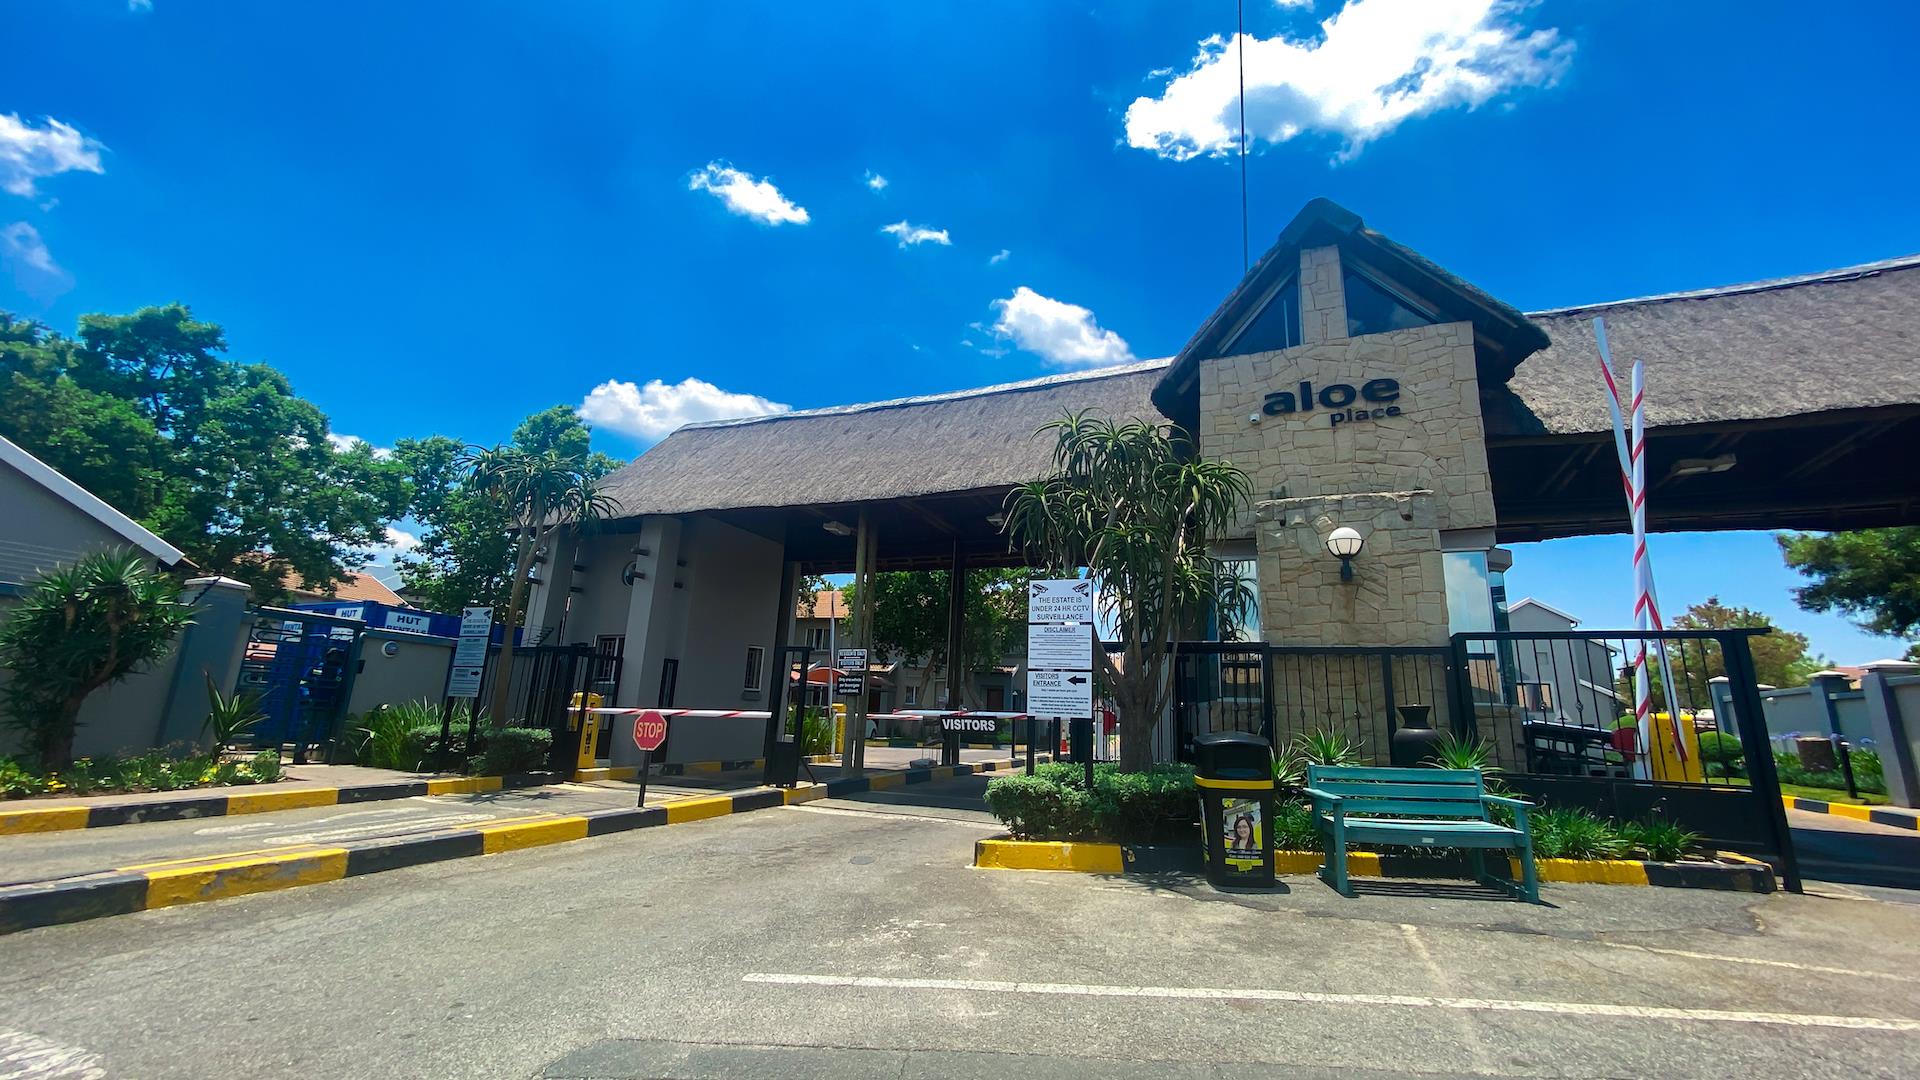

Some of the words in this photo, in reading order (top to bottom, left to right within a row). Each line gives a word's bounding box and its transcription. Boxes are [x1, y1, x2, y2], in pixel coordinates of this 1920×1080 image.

[1263, 379, 1399, 415] aloe
[1330, 406, 1400, 427] place
[341, 610, 358, 618] HUT
[396, 615, 421, 625] HUT
[1034, 672, 1060, 680] VISITORS
[636, 722, 664, 739] STOP
[941, 718, 996, 731] VISITORS
